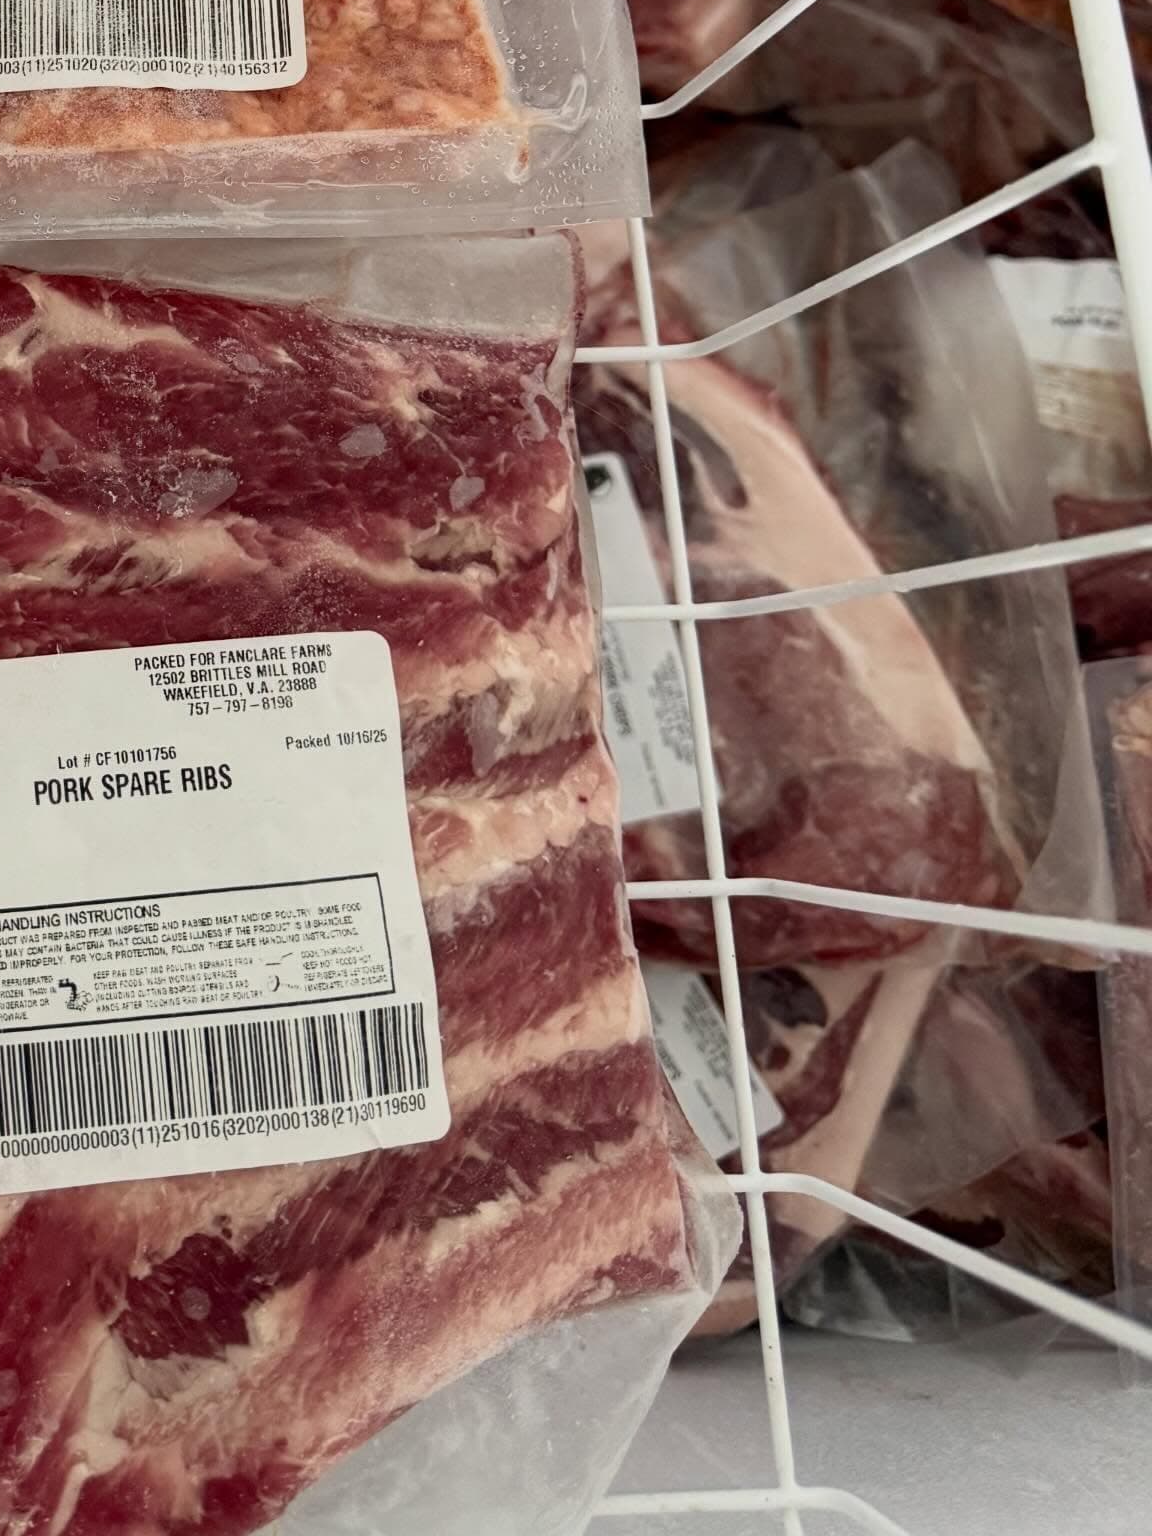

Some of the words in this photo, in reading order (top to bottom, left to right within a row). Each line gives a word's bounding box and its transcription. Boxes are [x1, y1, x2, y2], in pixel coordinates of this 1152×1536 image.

[135, 655, 185, 671] PACKED
[191, 653, 215, 667] FOR
[220, 647, 287, 665] FANCLARE
[291, 644, 332, 658] FARMS
[148, 672, 186, 686] 12502
[191, 666, 252, 683] BRITTLES
[257, 664, 288, 677] MILL
[293, 661, 326, 674] ROAD
[163, 684, 243, 701] WAKEFIELD,
[247, 681, 272, 695] V.A.
[279, 678, 317, 693] 23888
[286, 734, 331, 750] Packed
[336, 729, 387, 747] 10/16/25
[58, 755, 78, 769] Lot
[96, 746, 176, 766] CF10101756
[34, 776, 94, 805] PORK
[102, 770, 172, 800] SPARE
[181, 764, 233, 792] RIBS
[66, 904, 161, 926] INSTRUCTIONS
[43, 930, 86, 943] PREPARED
[115, 922, 158, 934] INSPECTED
[162, 920, 179, 930] AND
[27, 945, 62, 956] CONTAIN
[66, 941, 104, 952] BACTERIA
[132, 935, 158, 945] COULD
